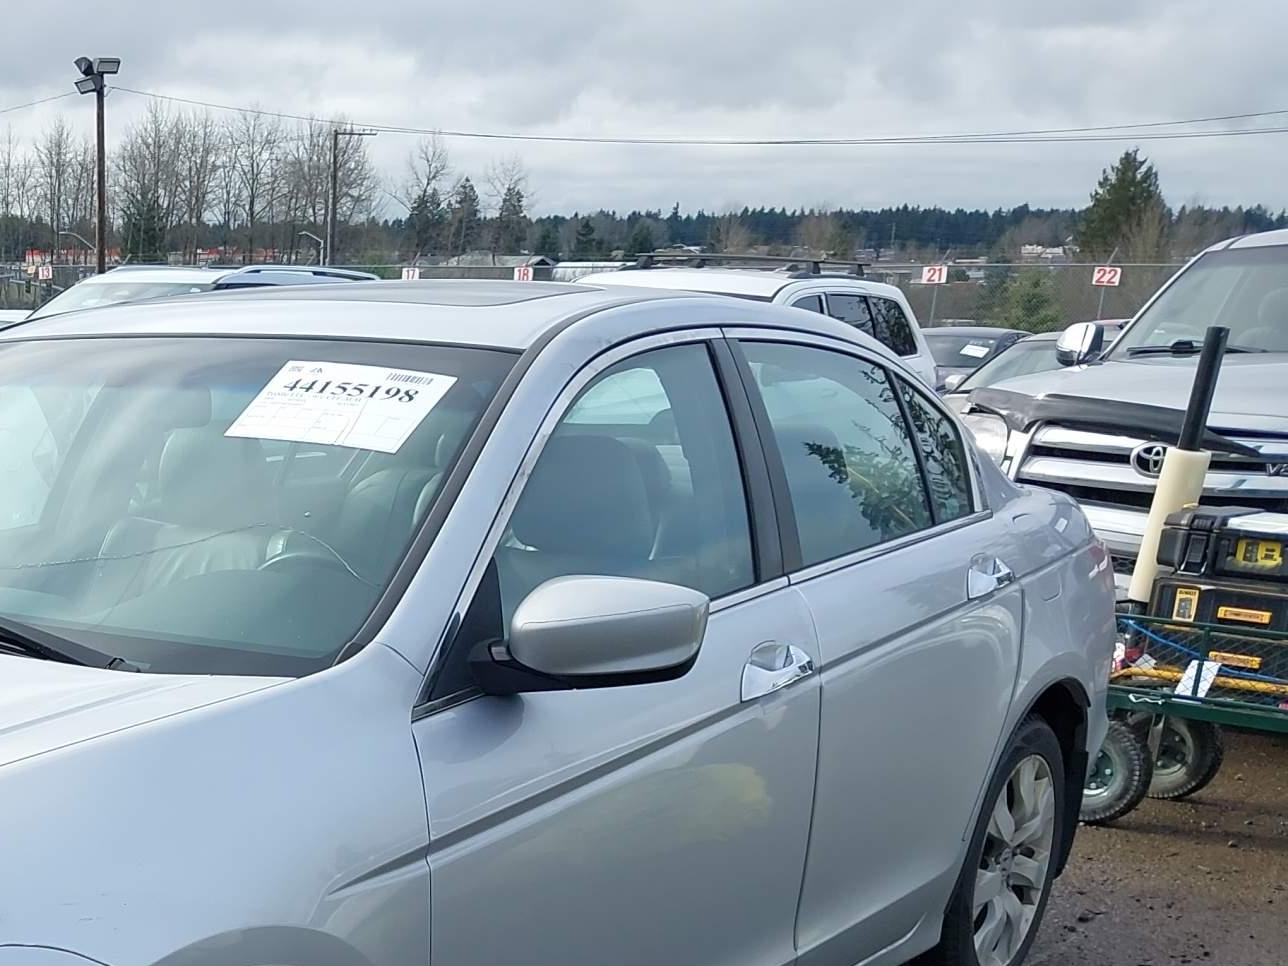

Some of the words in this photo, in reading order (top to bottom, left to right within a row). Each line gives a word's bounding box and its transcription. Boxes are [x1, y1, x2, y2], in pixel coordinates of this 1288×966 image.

[41, 267, 50, 278] 13
[406, 269, 416, 280] 17
[517, 268, 529, 281] 18
[926, 267, 943, 282] 21
[1095, 268, 1118, 284] 22
[283, 378, 420, 403] 44155198
